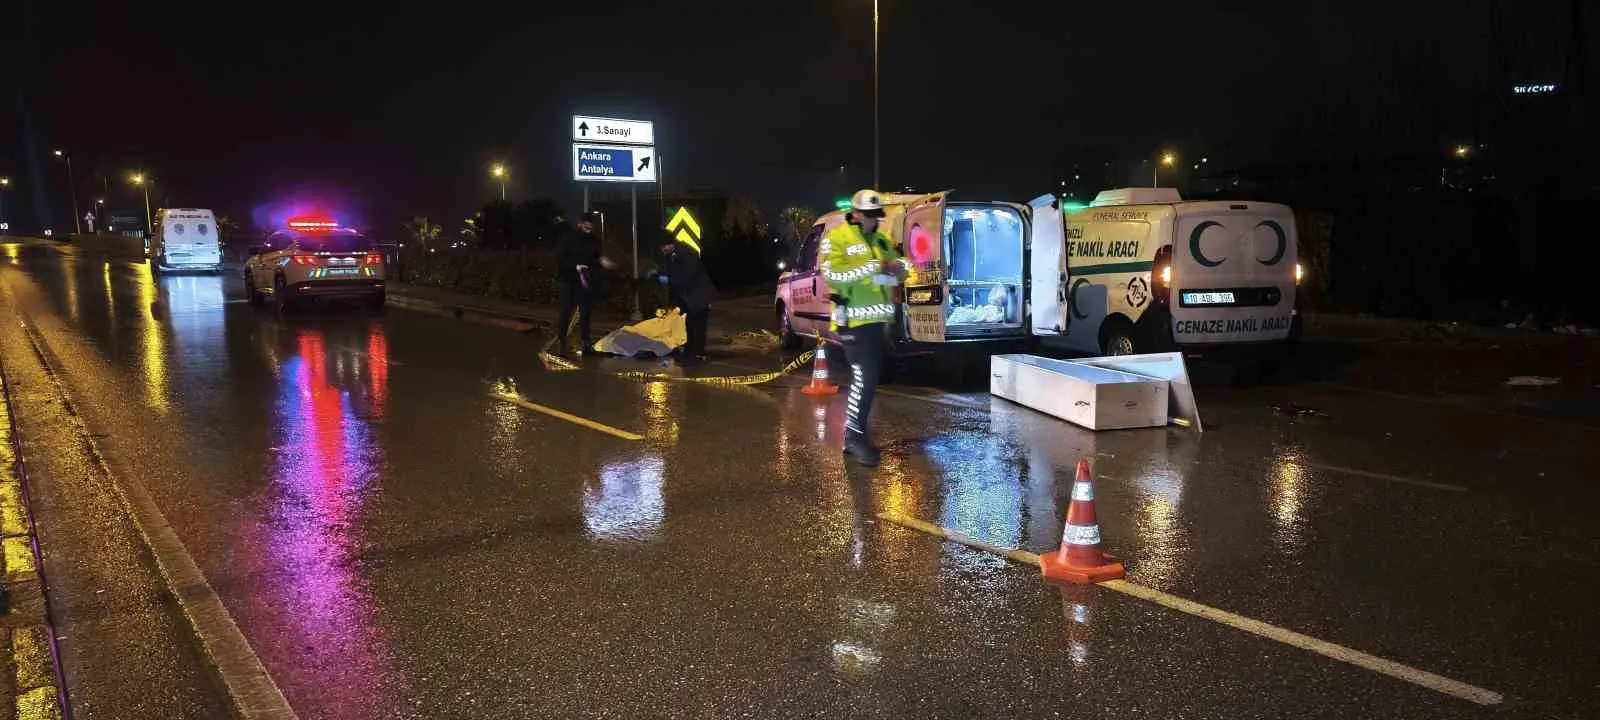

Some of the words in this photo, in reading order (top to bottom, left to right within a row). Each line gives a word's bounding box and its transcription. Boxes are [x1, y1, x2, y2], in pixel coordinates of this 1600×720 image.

[596, 125, 631, 137] 3.Sanayi
[580, 151, 611, 161] Ankara
[581, 165, 614, 175] Antalya
[1077, 236, 1104, 257] NAKİL
[1107, 240, 1139, 257] ARACI
[1176, 320, 1224, 334] CENAZE
[1226, 316, 1258, 333] NAKİL
[1260, 316, 1290, 330] ARACI
